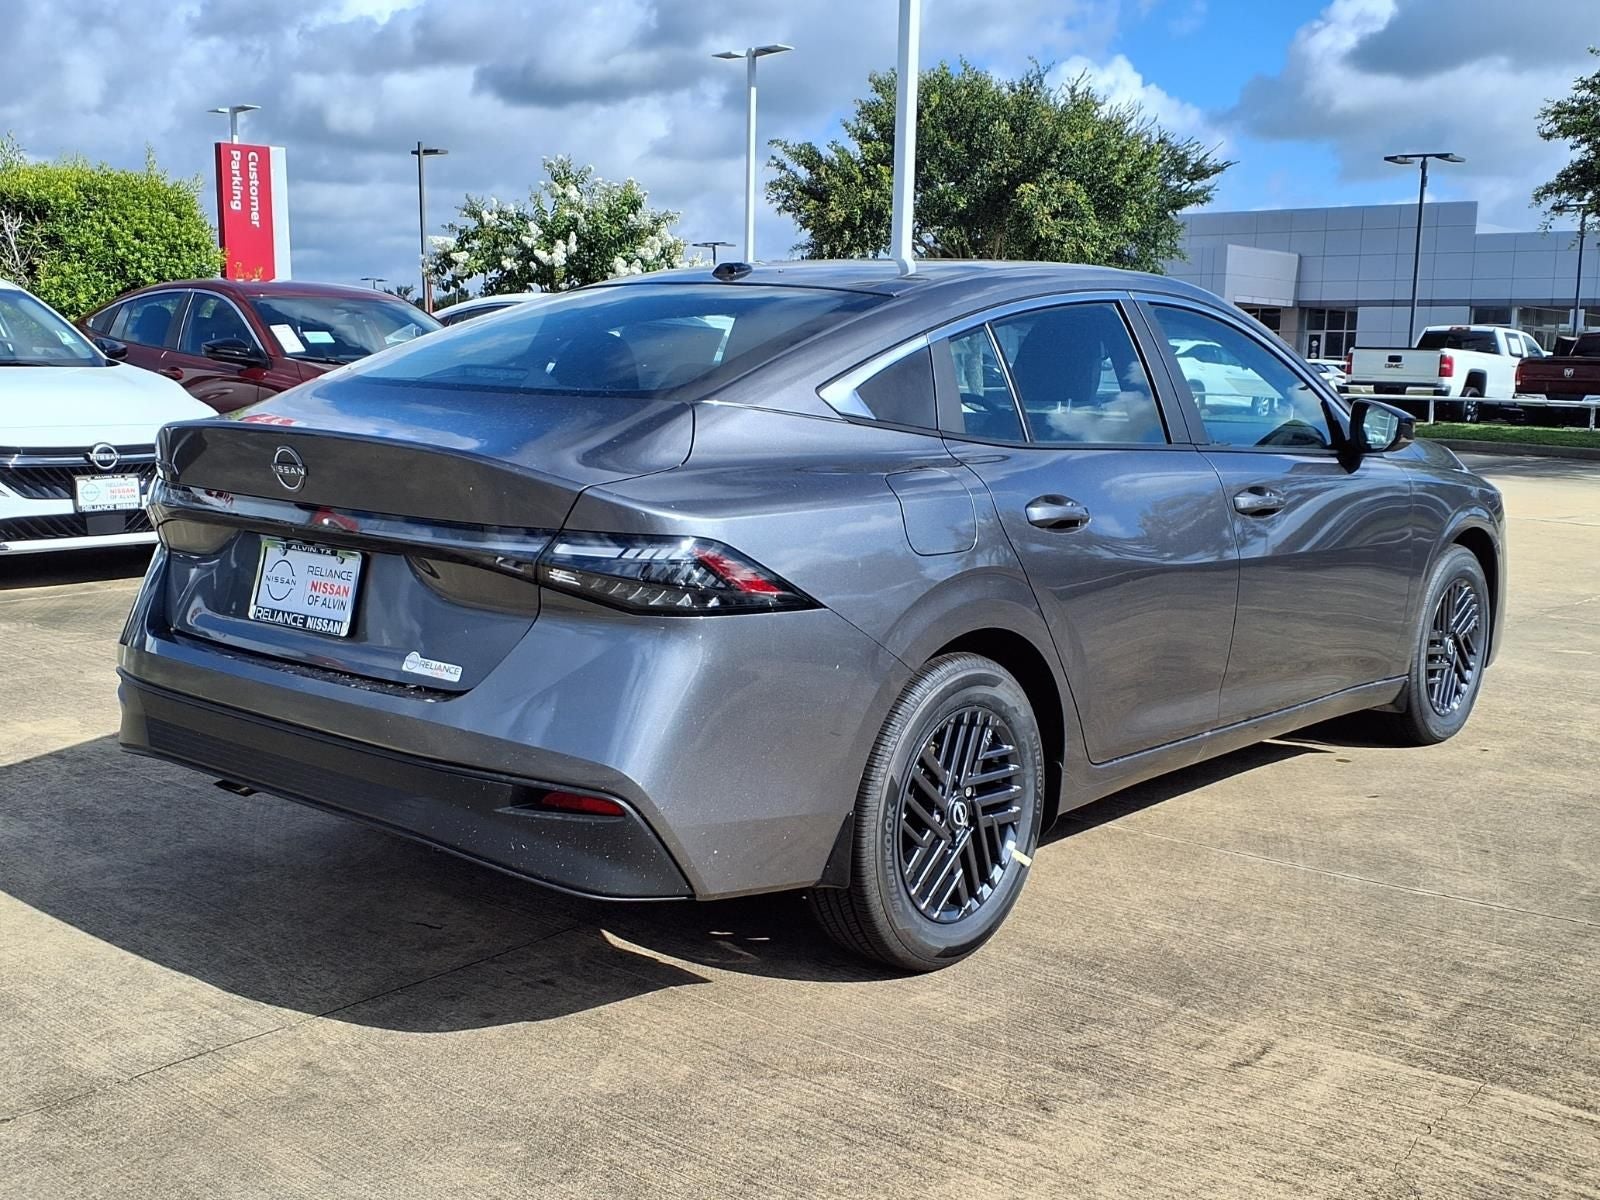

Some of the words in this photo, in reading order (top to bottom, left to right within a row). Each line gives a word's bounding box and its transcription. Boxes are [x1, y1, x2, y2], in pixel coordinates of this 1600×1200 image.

[230, 150, 243, 211] Parking
[248, 151, 260, 228] Customer
[265, 575, 297, 586] NISSAN
[307, 565, 353, 582] RELIANCE
[310, 580, 350, 598] NISSAN
[307, 594, 320, 606] OF
[320, 597, 347, 612] ALVIN
[255, 607, 305, 627] RELIANCE
[306, 616, 342, 634] NISSAN
[420, 660, 461, 676] RELIANCE
